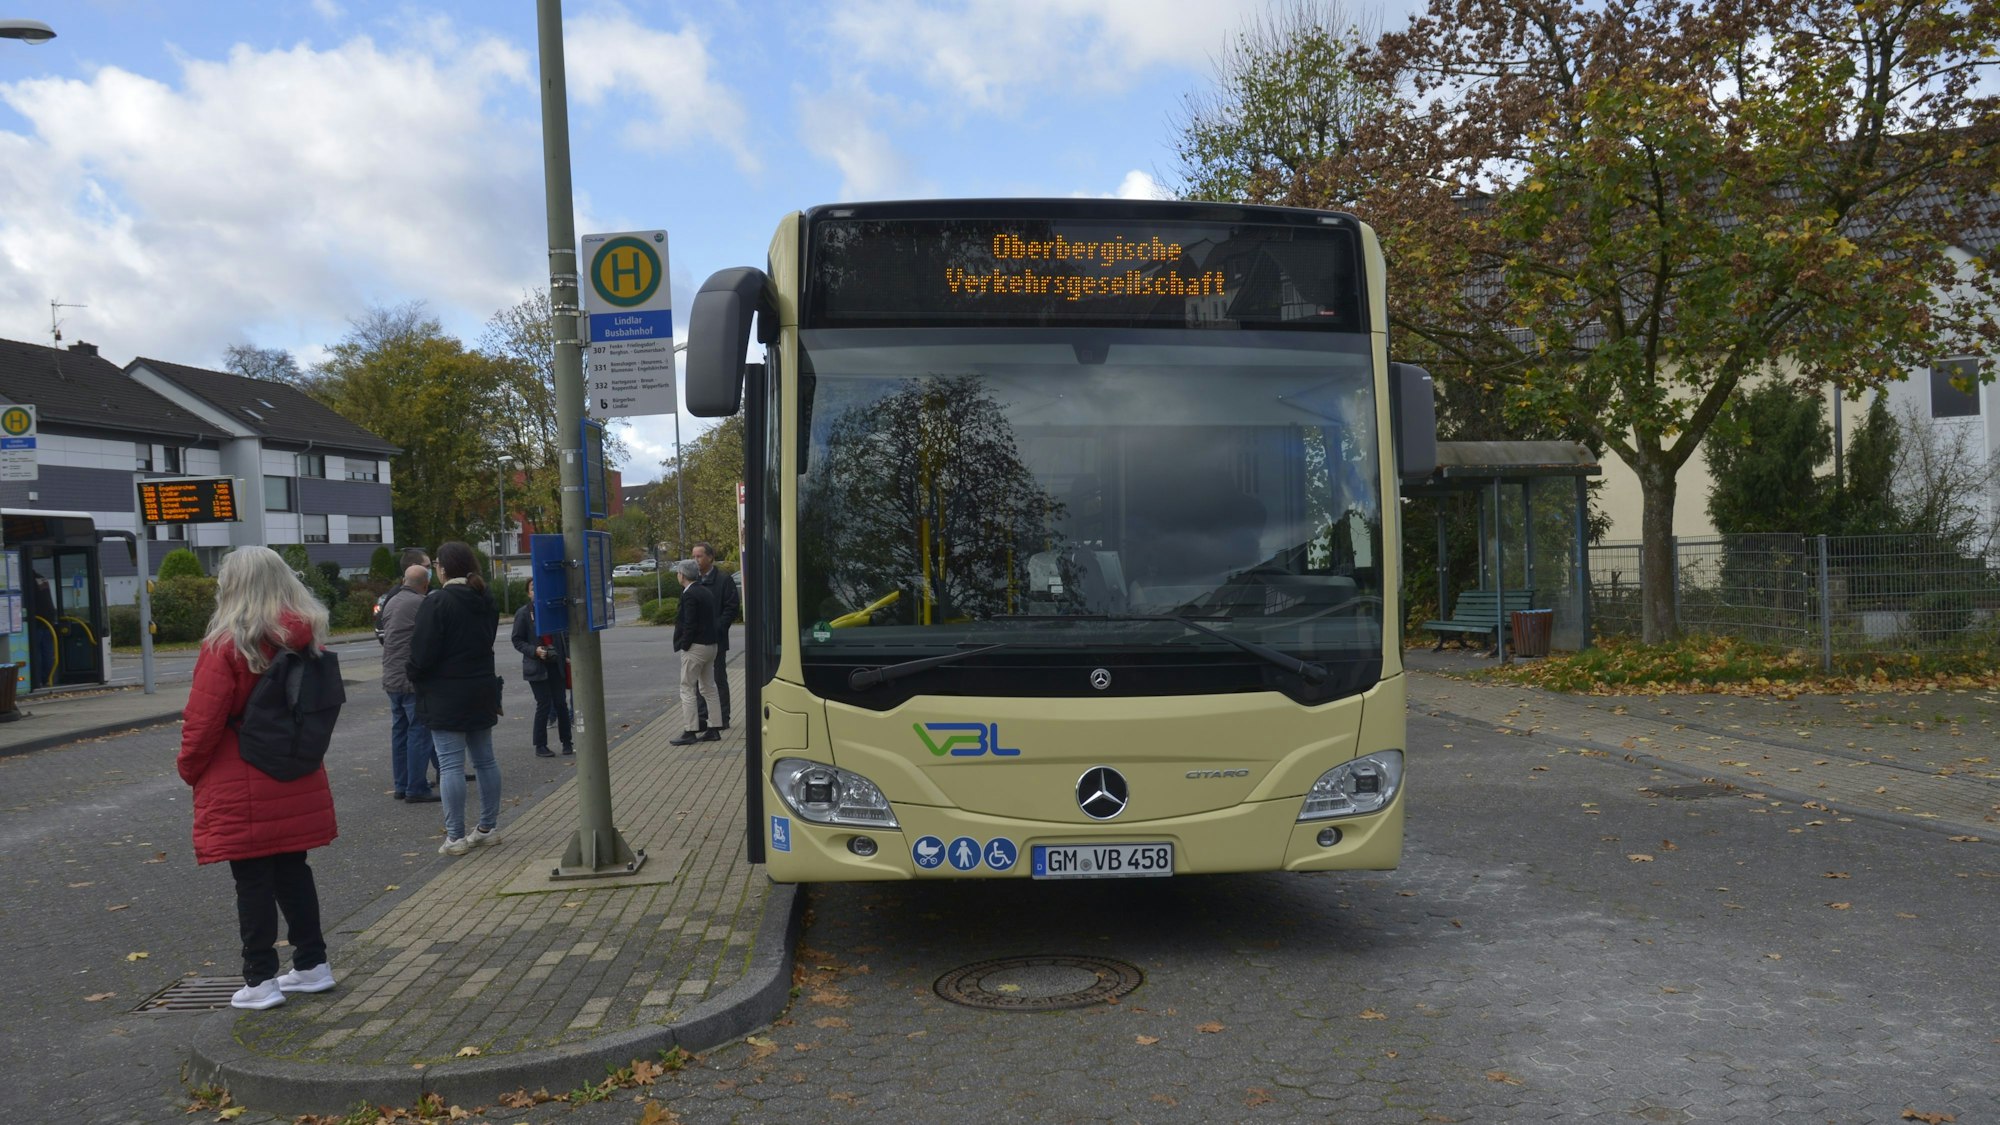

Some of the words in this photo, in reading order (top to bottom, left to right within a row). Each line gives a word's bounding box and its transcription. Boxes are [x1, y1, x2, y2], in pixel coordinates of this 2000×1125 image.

[992, 233, 1182, 266] Oberbergische
[612, 252, 640, 291] H
[946, 268, 1224, 300] Verkehrsgesellschaft
[605, 327, 653, 337] Busbahnhof
[615, 317, 642, 325] Lindlar
[913, 722, 1021, 756] VBL
[1048, 850, 1077, 871] GM
[1094, 849, 1122, 870] VB
[1128, 848, 1168, 869] 458
